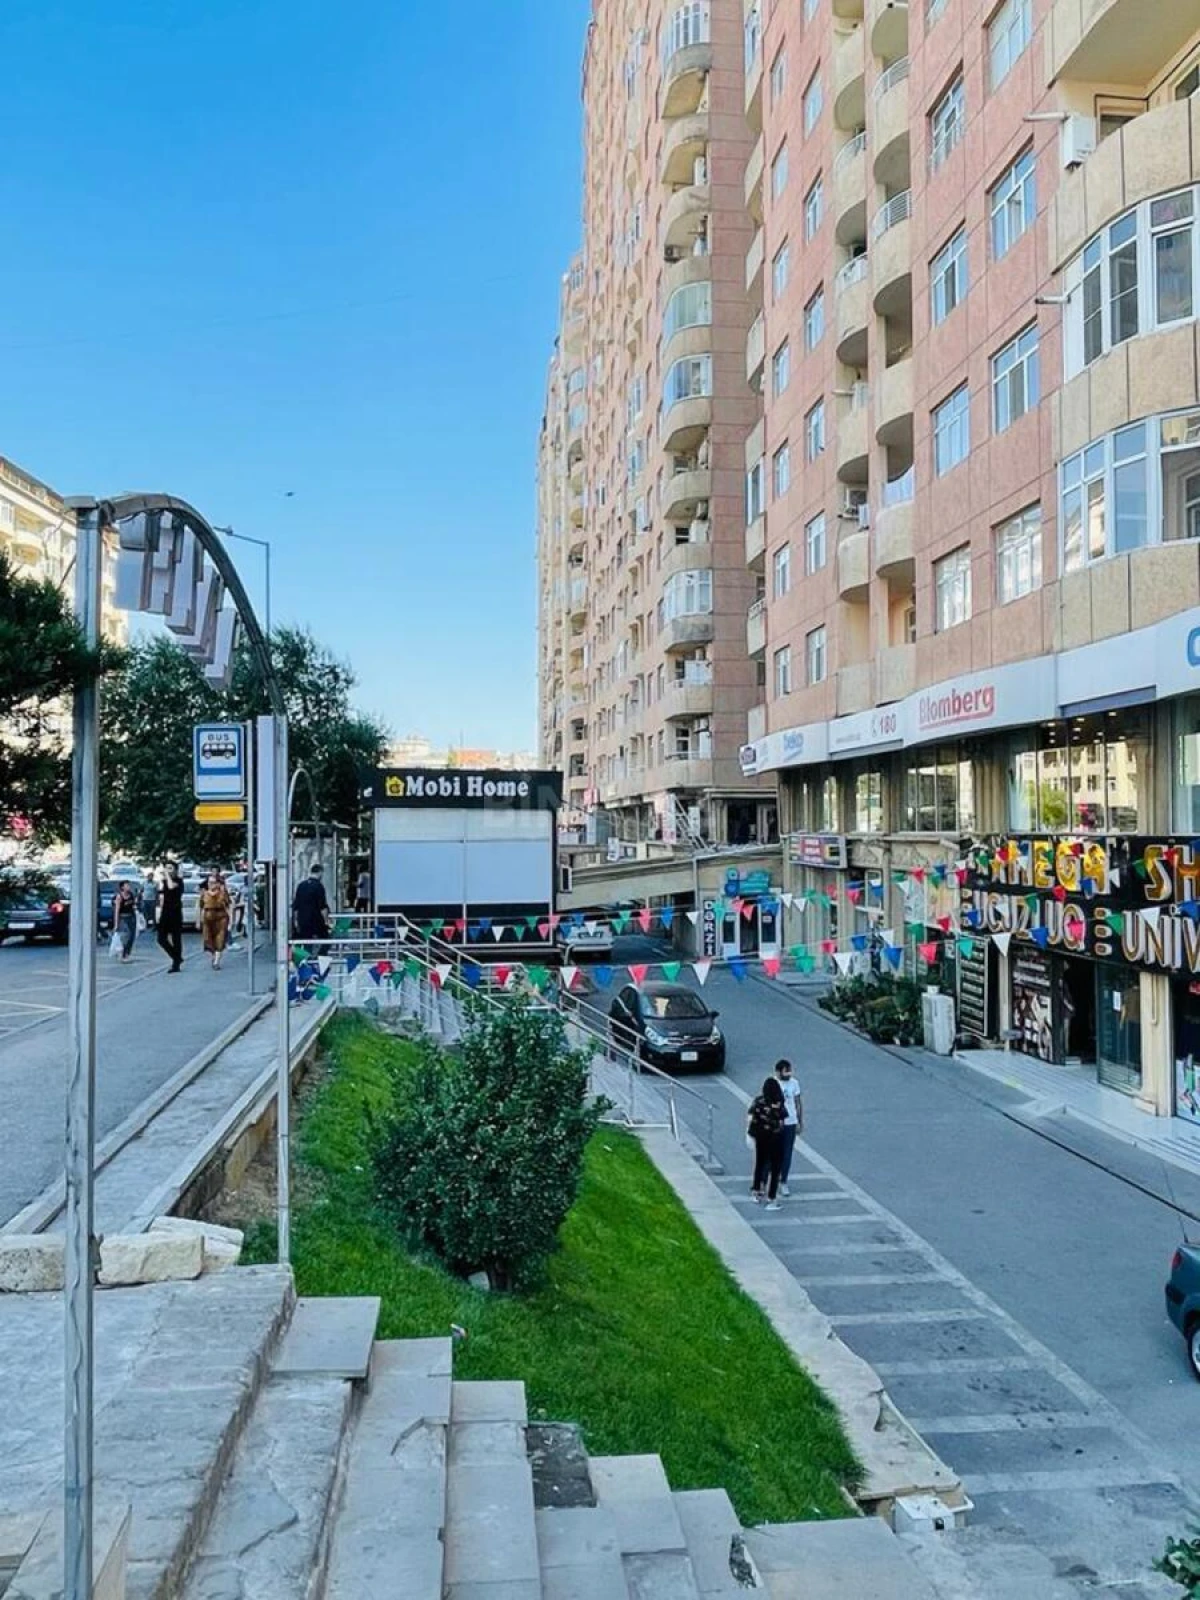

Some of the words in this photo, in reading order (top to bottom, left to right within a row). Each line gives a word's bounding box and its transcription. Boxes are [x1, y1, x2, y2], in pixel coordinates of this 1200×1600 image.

[919, 686, 995, 726] Blomberg
[207, 733, 230, 741] BUS
[406, 775, 461, 797] Mobi
[466, 775, 529, 797] Home
